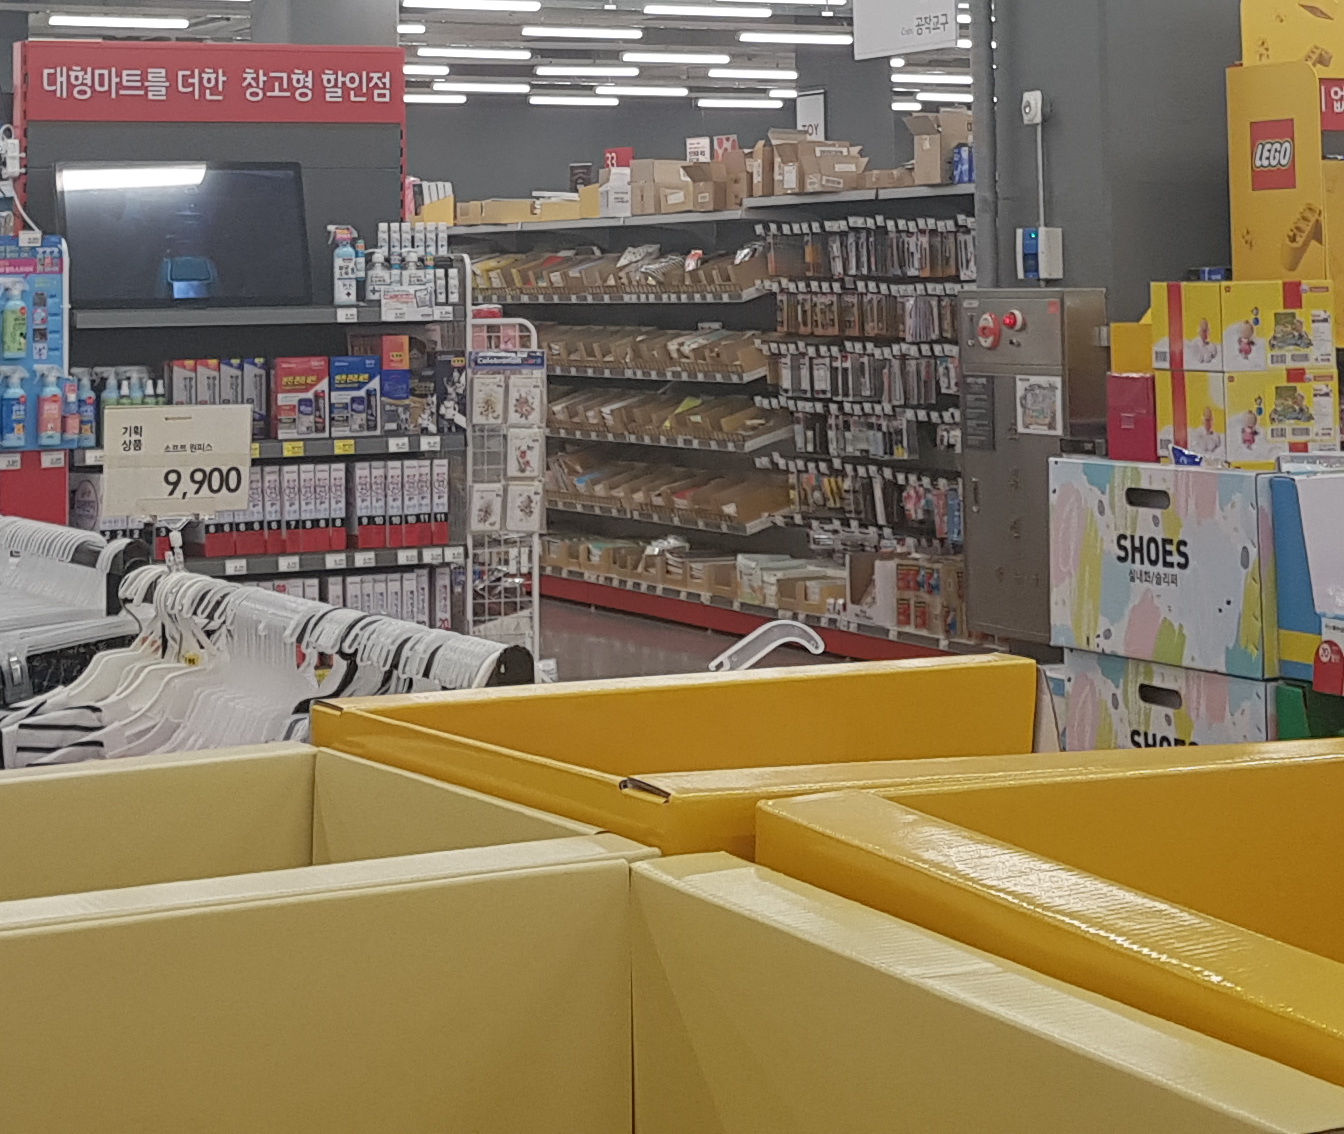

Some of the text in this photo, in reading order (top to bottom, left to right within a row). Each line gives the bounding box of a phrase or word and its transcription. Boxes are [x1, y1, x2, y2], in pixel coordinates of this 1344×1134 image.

[43, 66, 391, 103] 대형마트를 더한 창고형 할인점
[1254, 139, 1293, 170] LEGO
[121, 425, 143, 438] 기획
[121, 438, 143, 452] 상품
[163, 466, 243, 500] 9,900
[1116, 533, 1189, 570] SHOES
